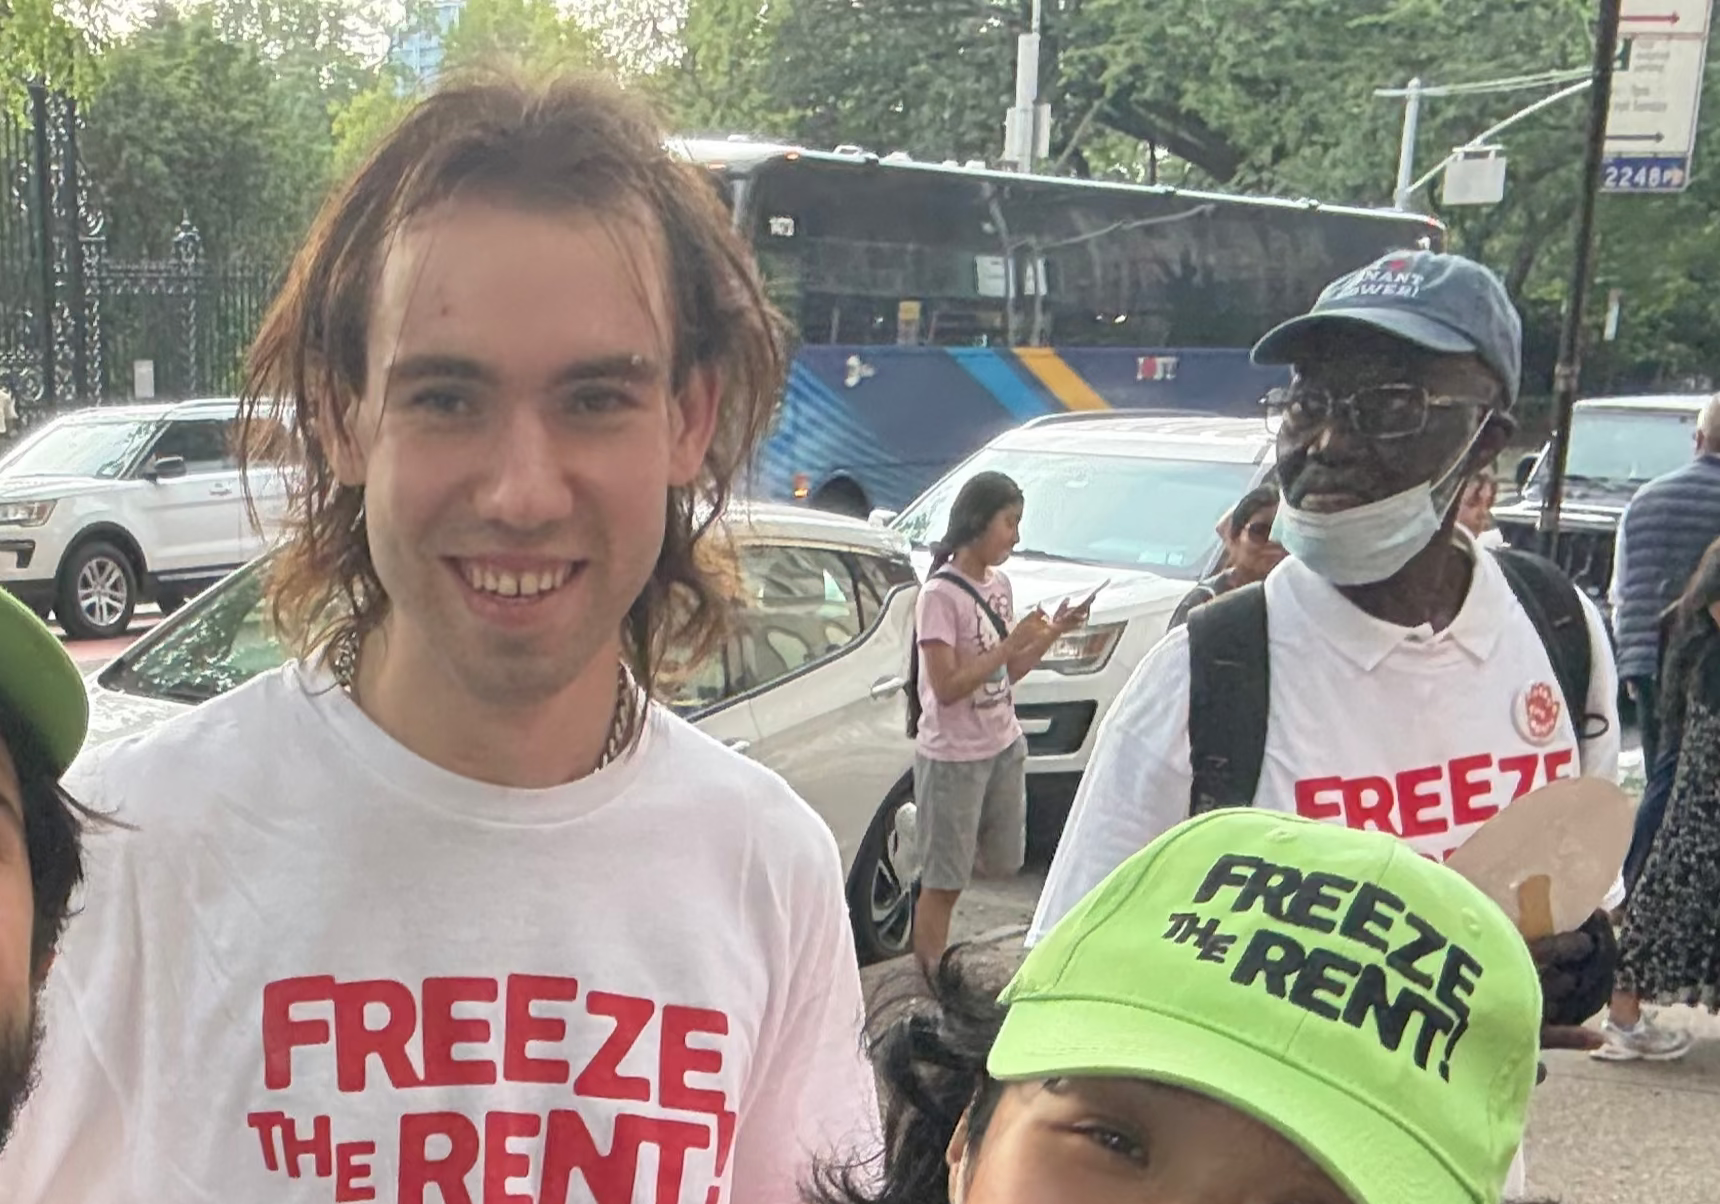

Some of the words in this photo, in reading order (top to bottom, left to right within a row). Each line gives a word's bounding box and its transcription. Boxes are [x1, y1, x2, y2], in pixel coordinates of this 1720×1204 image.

[1161, 912, 1238, 963] THE
[1230, 928, 1469, 1083] RENT!
[1193, 853, 1484, 1018] FREEZE
[262, 973, 729, 1112] FREEZE
[247, 1110, 376, 1203] THE
